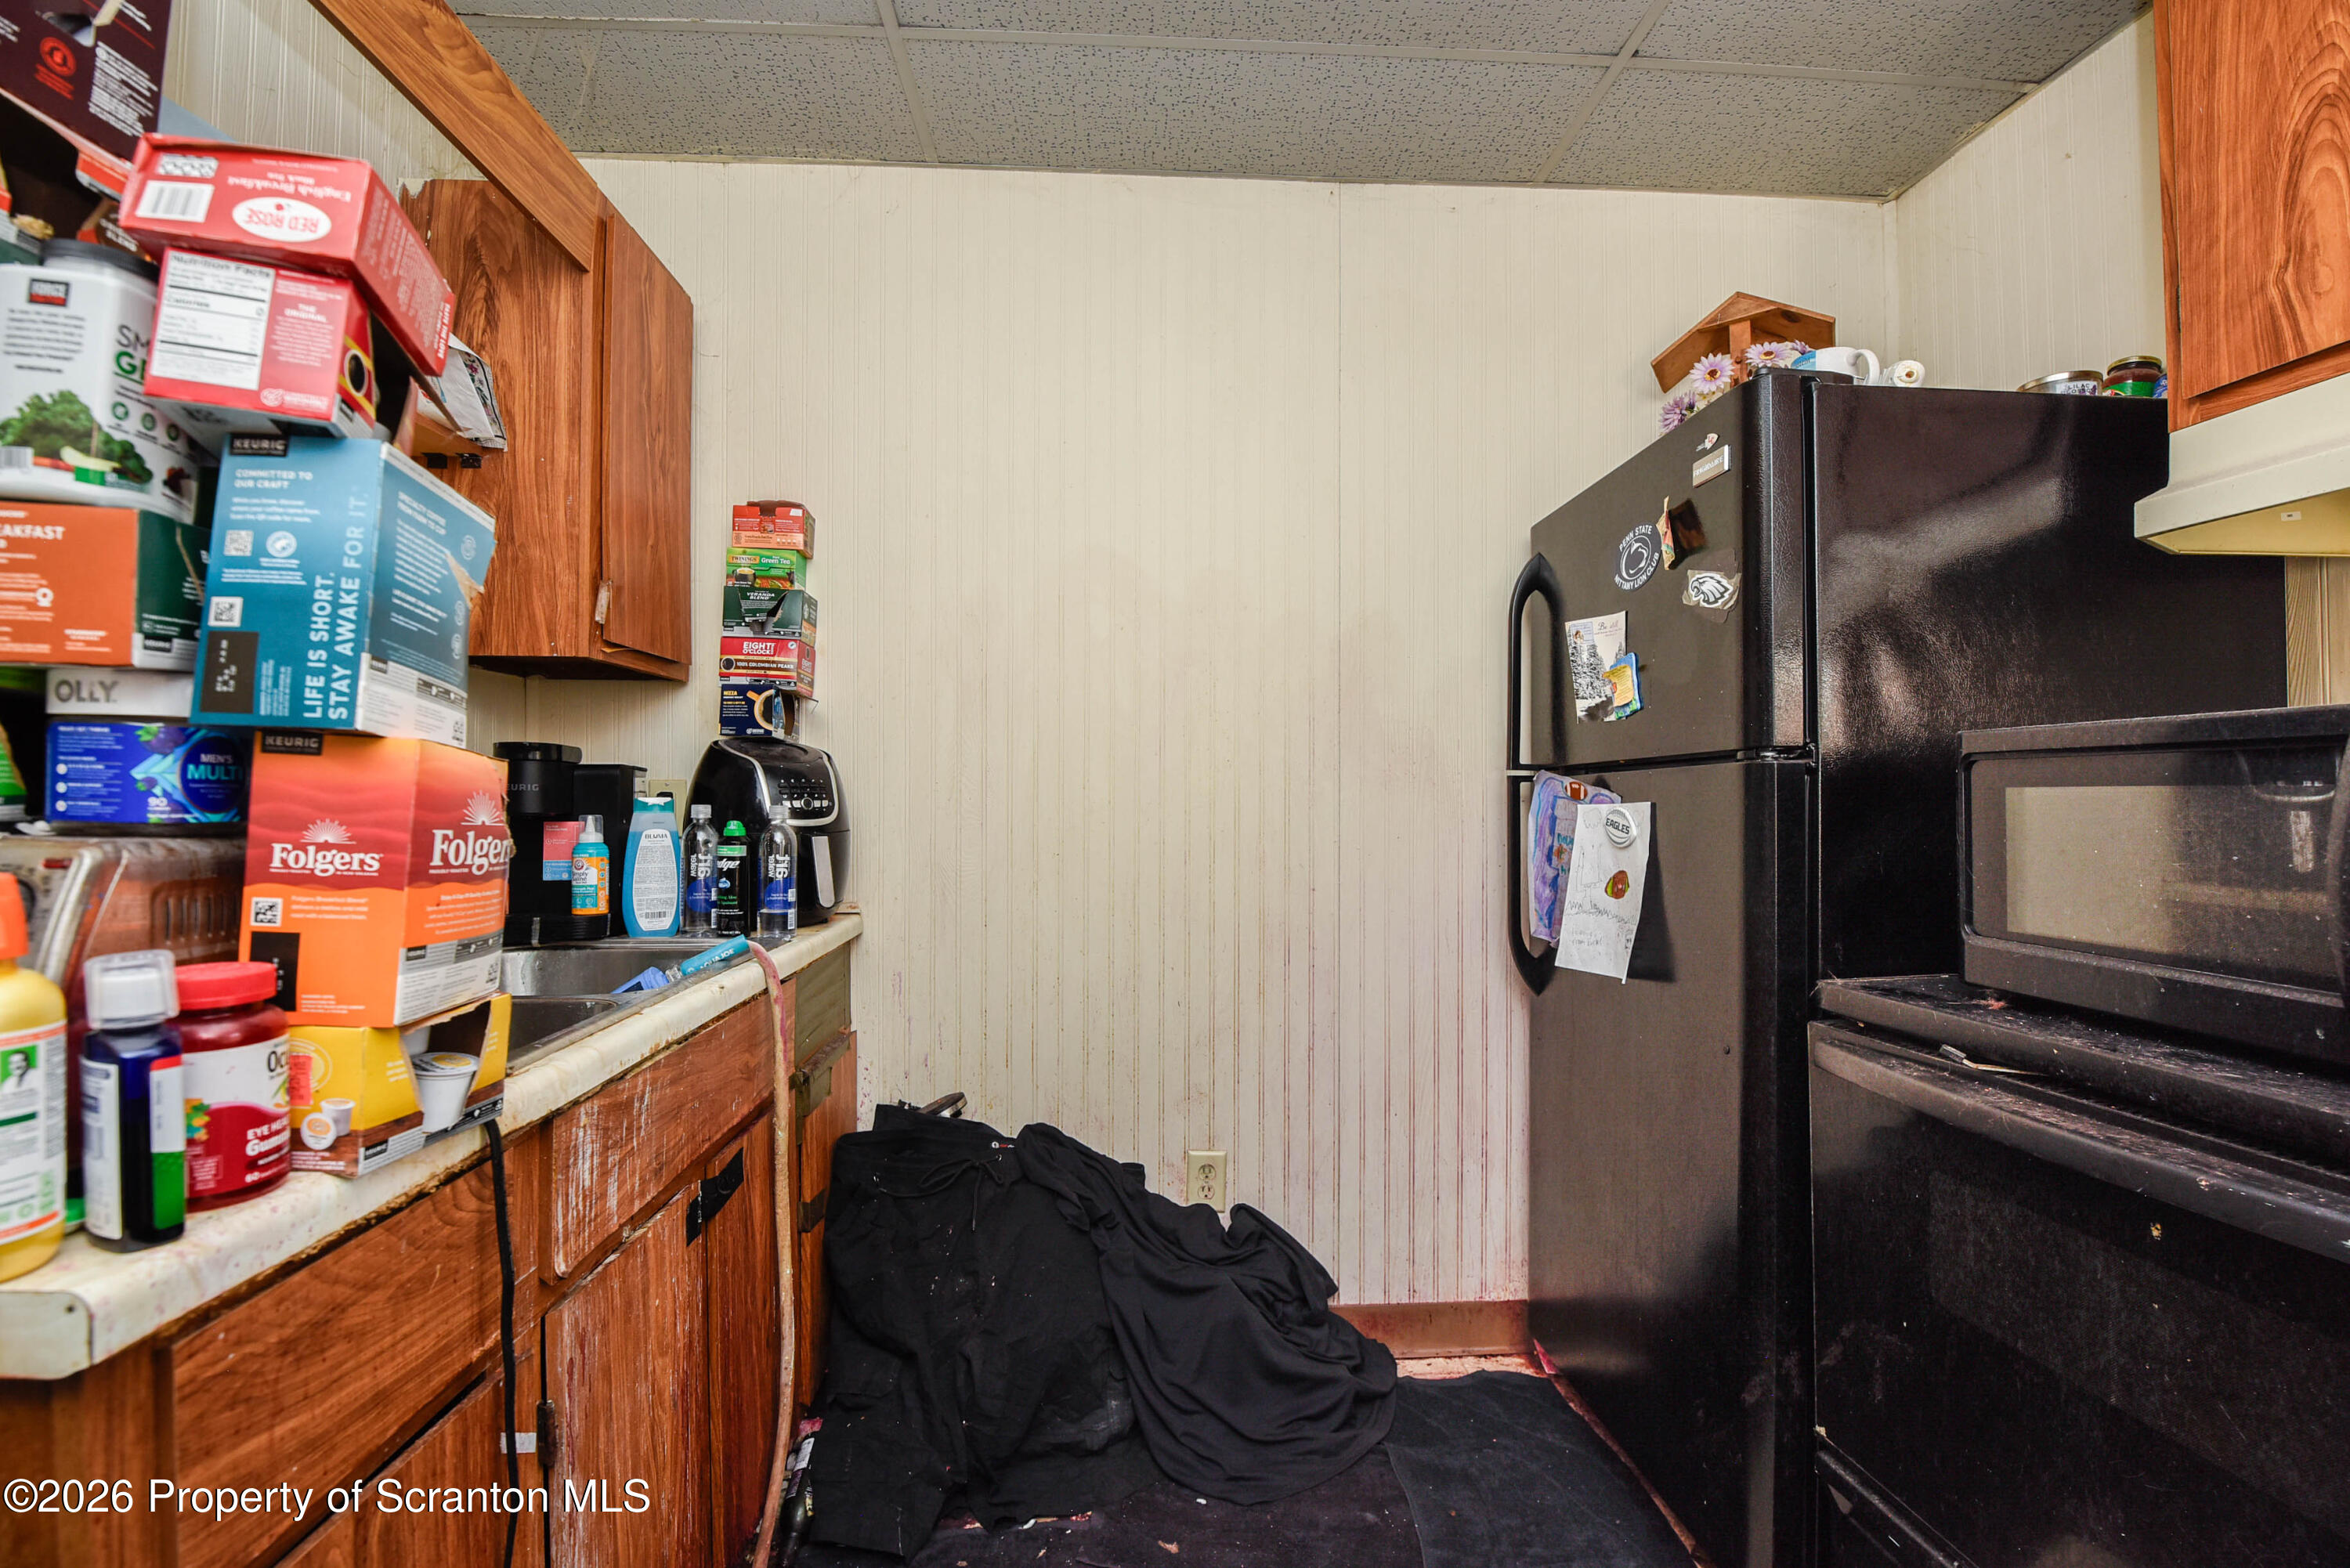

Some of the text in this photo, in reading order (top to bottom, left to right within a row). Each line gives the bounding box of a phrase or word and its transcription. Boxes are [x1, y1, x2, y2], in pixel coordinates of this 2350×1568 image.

[227, 176, 352, 203] English Breakfast
[244, 208, 320, 233] RED ROSE
[437, 338, 446, 359] LOVE
[233, 439, 287, 450] KEURIG
[234, 479, 290, 489] OUR CRAFT
[235, 469, 313, 480] COMMITTED TO
[343, 526, 364, 569] FOR
[1619, 525, 1652, 551] PENN STATE
[1614, 551, 1660, 591] NITTANY LION CLUB
[334, 577, 361, 656] AWAKE
[303, 572, 335, 718] LIFE IS SHORT.
[55, 679, 117, 704] OLLY
[327, 664, 352, 720] STAY
[266, 735, 320, 748] KEURIG
[201, 753, 233, 764] MEN'S
[187, 764, 244, 781] MULTI
[1606, 817, 1630, 835] EAGLES
[269, 843, 381, 876] Folgers
[429, 829, 511, 876] Folger
[721, 948, 736, 958] JOE
[247, 1124, 270, 1140] EYE
